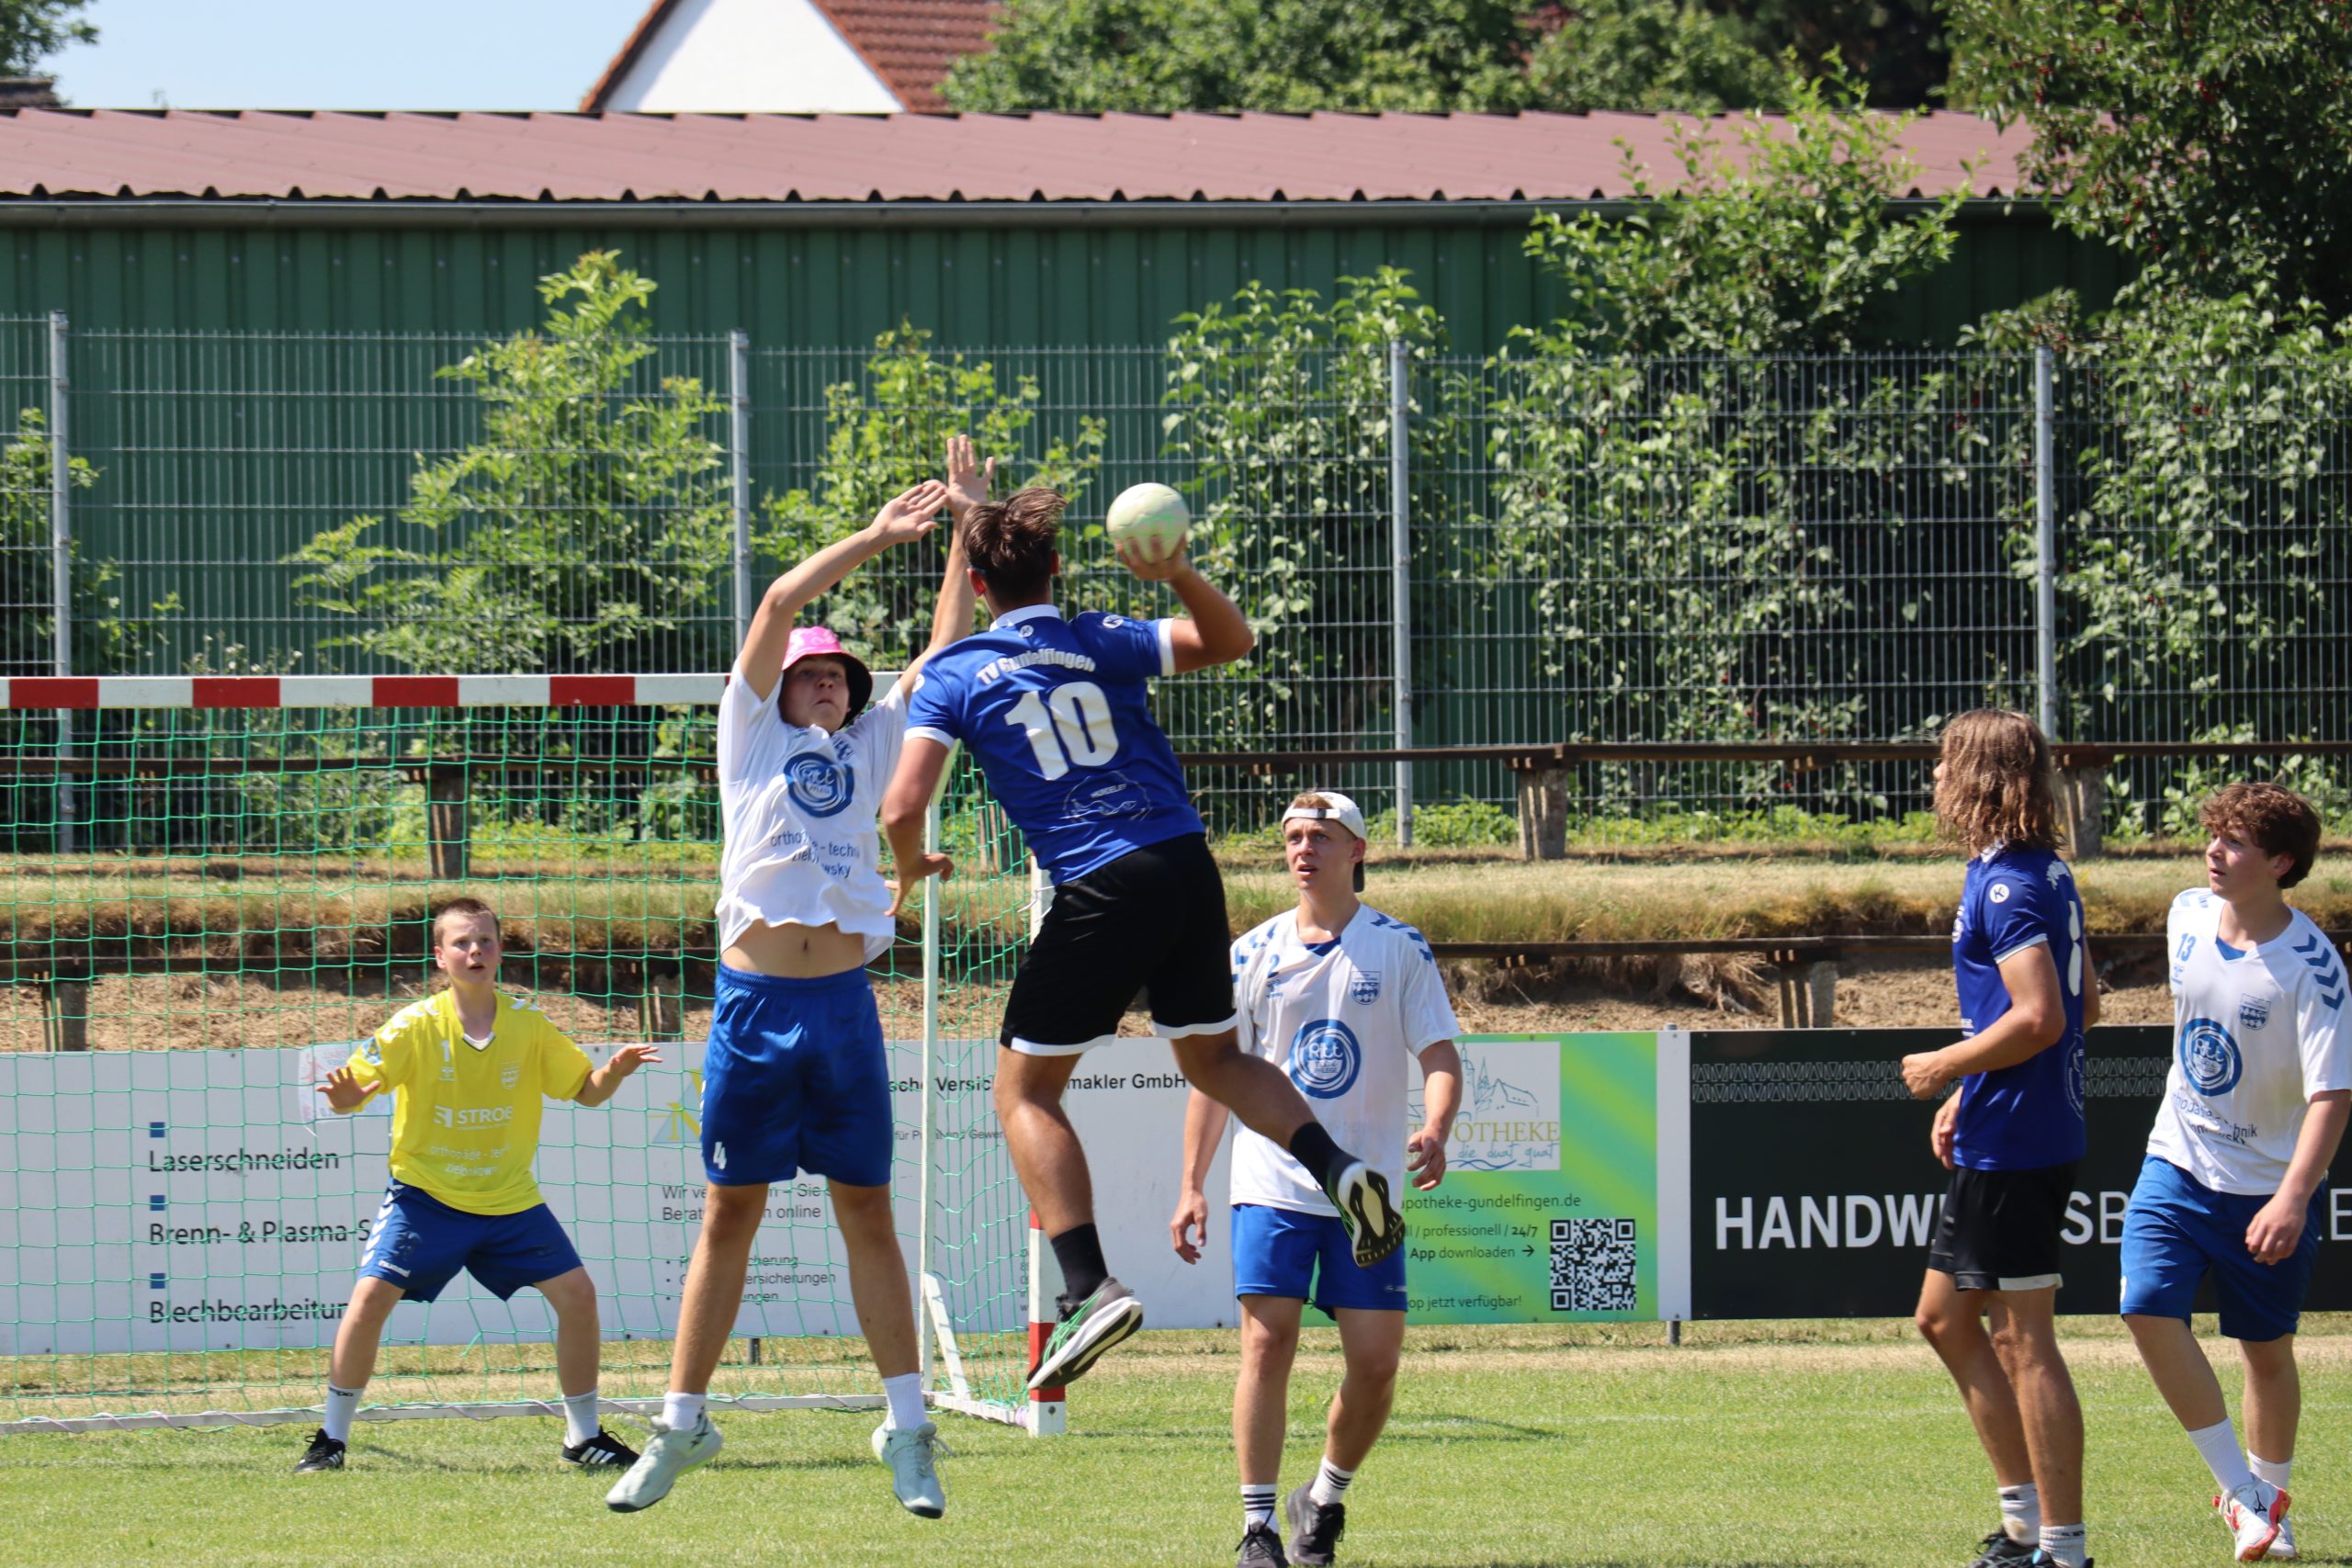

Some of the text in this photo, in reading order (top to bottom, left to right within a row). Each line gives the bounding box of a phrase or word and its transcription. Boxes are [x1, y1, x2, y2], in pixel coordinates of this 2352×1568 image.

[977, 664, 1001, 685] TV
[1003, 681, 1119, 781] 10
[2176, 932, 2197, 962] 13
[1268, 953, 1280, 978] 2
[440, 1040, 450, 1063] 1
[1131, 1073, 1186, 1089] GmbH
[969, 1129, 1004, 1141] Gewer
[713, 1141, 728, 1170] 4
[1458, 1141, 1476, 1158] die
[149, 1147, 340, 1173] Laserschneiden
[662, 1185, 689, 1200] Wir
[797, 1183, 821, 1198] Sie
[776, 1204, 821, 1219] online
[150, 1219, 371, 1246] Brenn- & Plasma-S
[1423, 1224, 1502, 1241] professionell
[1511, 1225, 1539, 1238] 24/7
[1410, 1245, 1516, 1262] App downloaden
[1426, 1297, 1455, 1311] jetzt
[1459, 1295, 1522, 1311] verfügbar!
